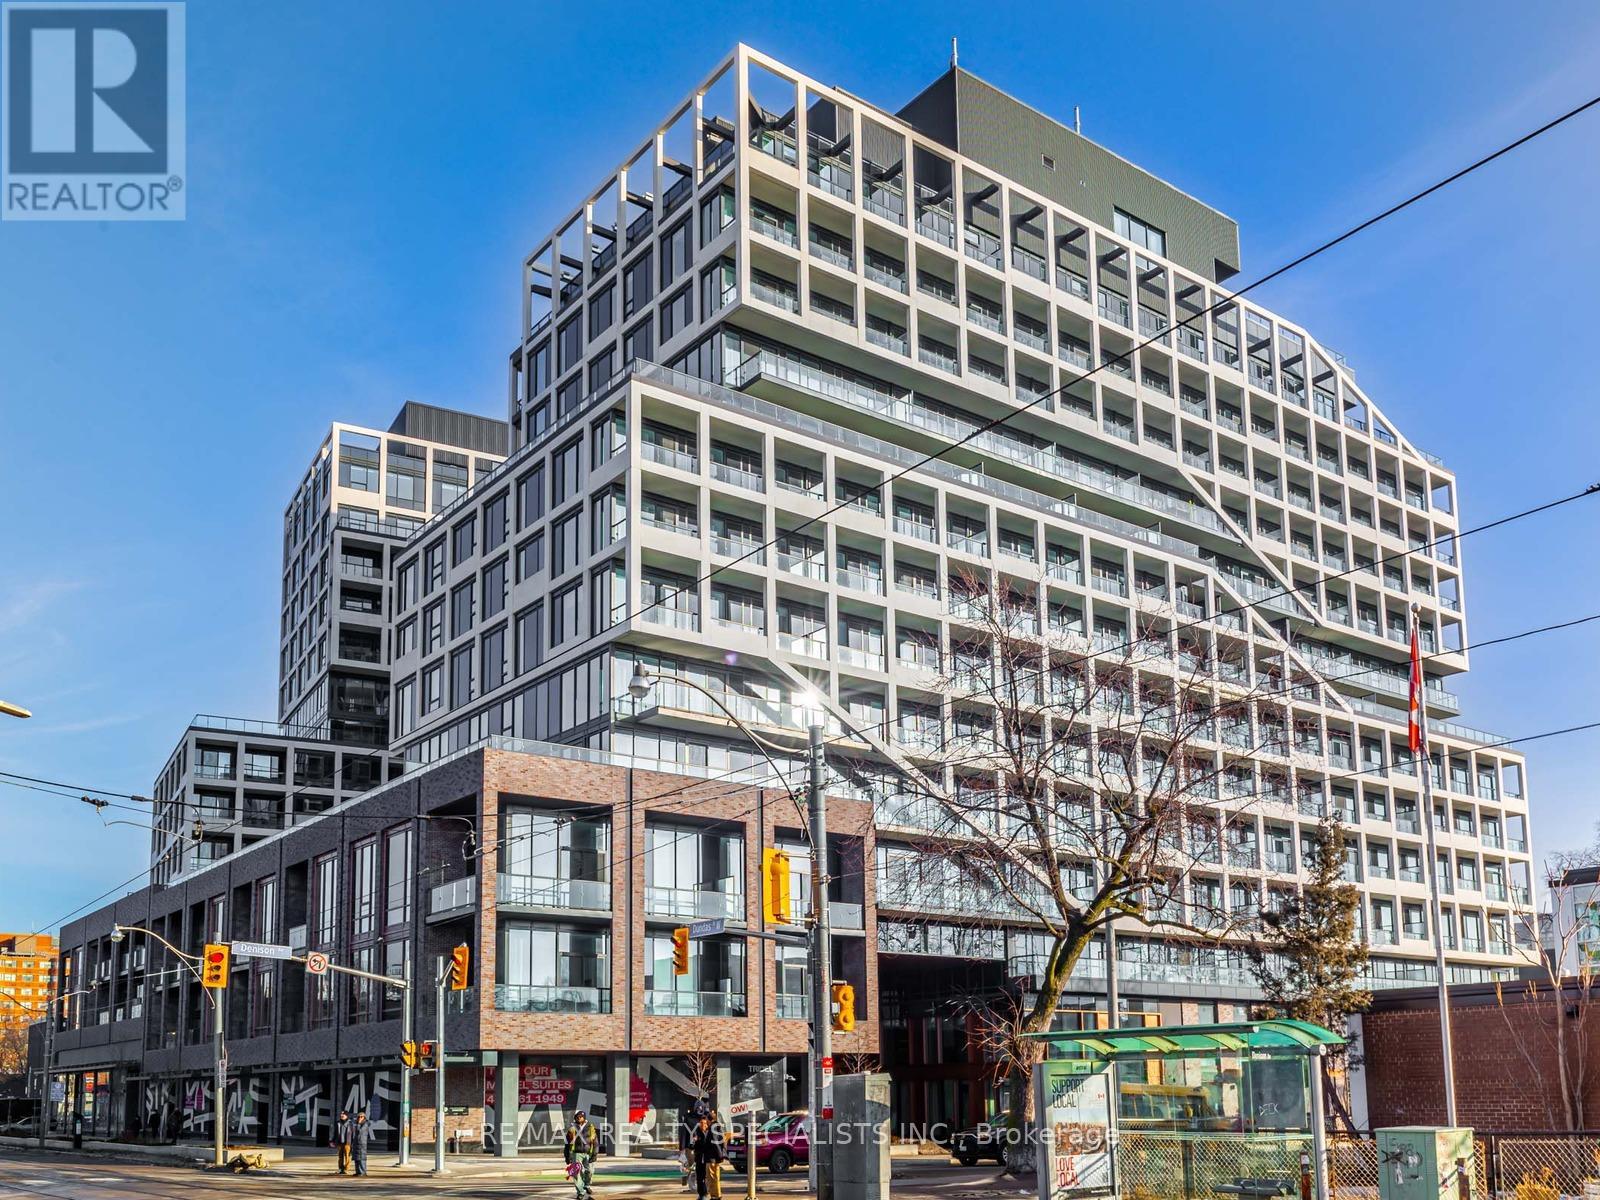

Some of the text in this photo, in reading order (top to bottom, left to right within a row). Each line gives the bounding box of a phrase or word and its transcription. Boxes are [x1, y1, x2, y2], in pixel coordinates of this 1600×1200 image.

[241, 944, 275, 955] Denison
[524, 1066, 549, 1076] OUR
[532, 1080, 572, 1090] SUITES
[1051, 1078, 1085, 1094] SUPPORT
[1052, 1093, 1077, 1109] LOCAL
[1056, 1156, 1075, 1172] LOVE
